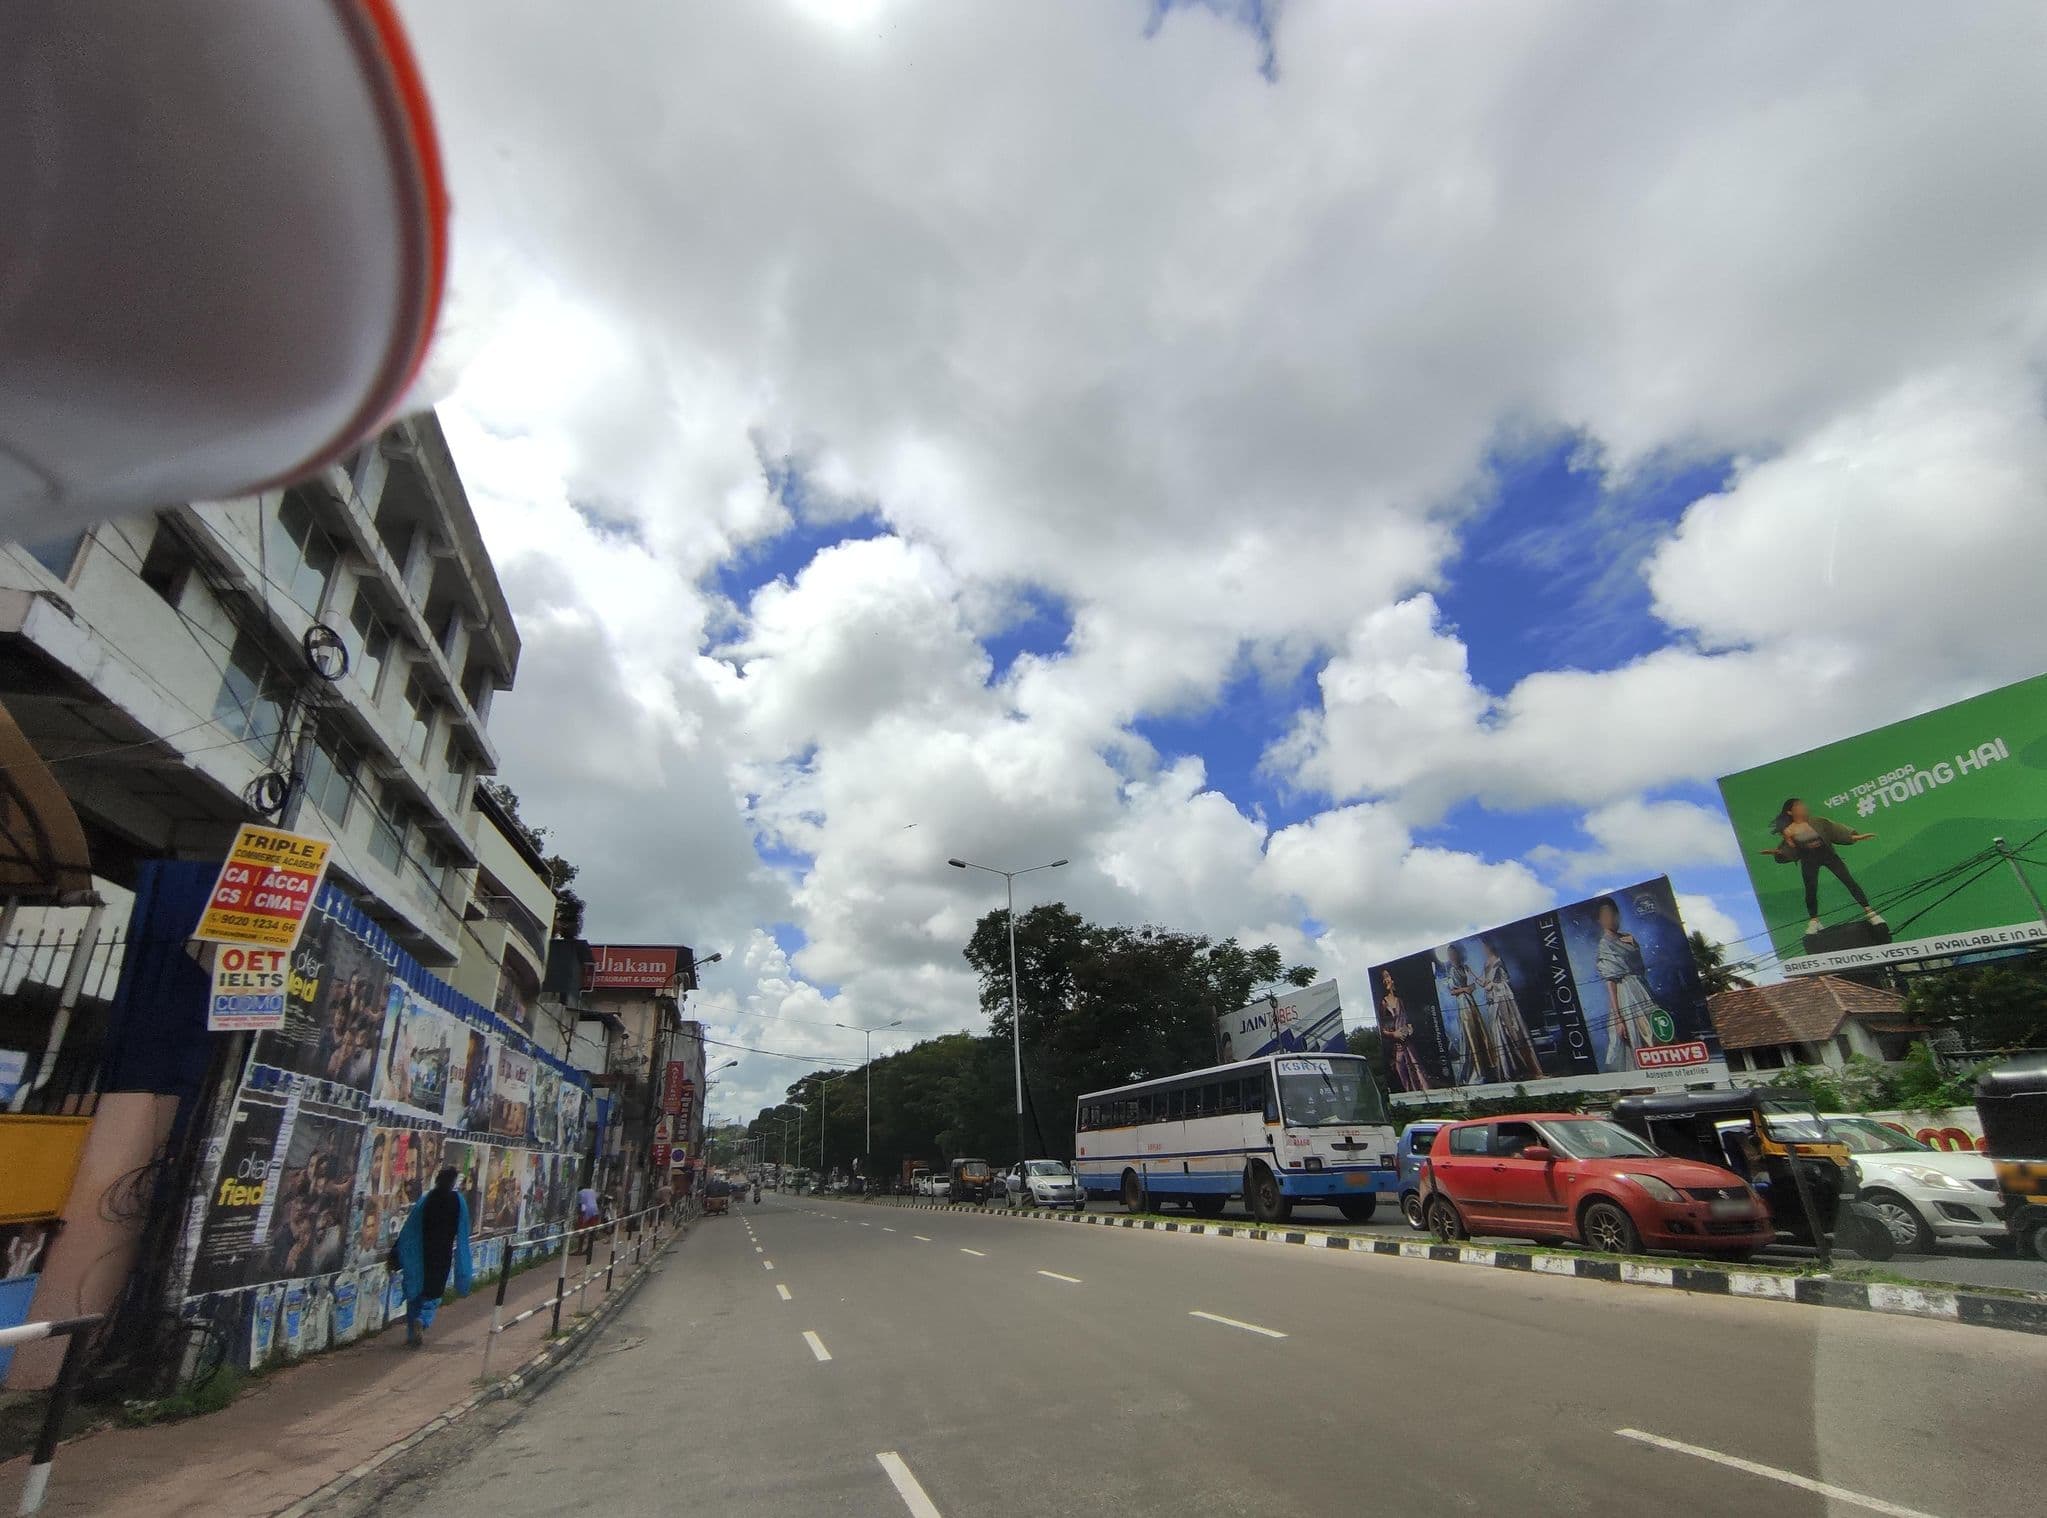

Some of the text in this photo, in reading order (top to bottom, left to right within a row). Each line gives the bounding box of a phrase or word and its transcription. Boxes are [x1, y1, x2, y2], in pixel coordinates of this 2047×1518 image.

[1955, 737, 2009, 775] HAI
[1824, 792, 1849, 809] YEH
[1849, 780, 1877, 800] TOH
[244, 833, 314, 858] TRIPLE
[235, 849, 321, 870] COMMERCE ACADEMY
[225, 867, 250, 885] CA
[262, 873, 309, 894] ACCA
[216, 887, 242, 904] CS
[254, 893, 292, 911] CMA
[220, 914, 249, 927] 9020
[252, 918, 279, 930] 1234
[222, 948, 286, 971] OET
[1785, 959, 1820, 973] BRIEFS
[1828, 953, 1874, 967] TRUNKS
[1883, 946, 1919, 959] VESTS
[1935, 932, 2009, 951] AVAILABLE
[2011, 930, 2025, 941] IN
[219, 973, 284, 987] IELTS
[587, 975, 632, 984] RSTAURANT
[1641, 1046, 1703, 1065] POTHYS
